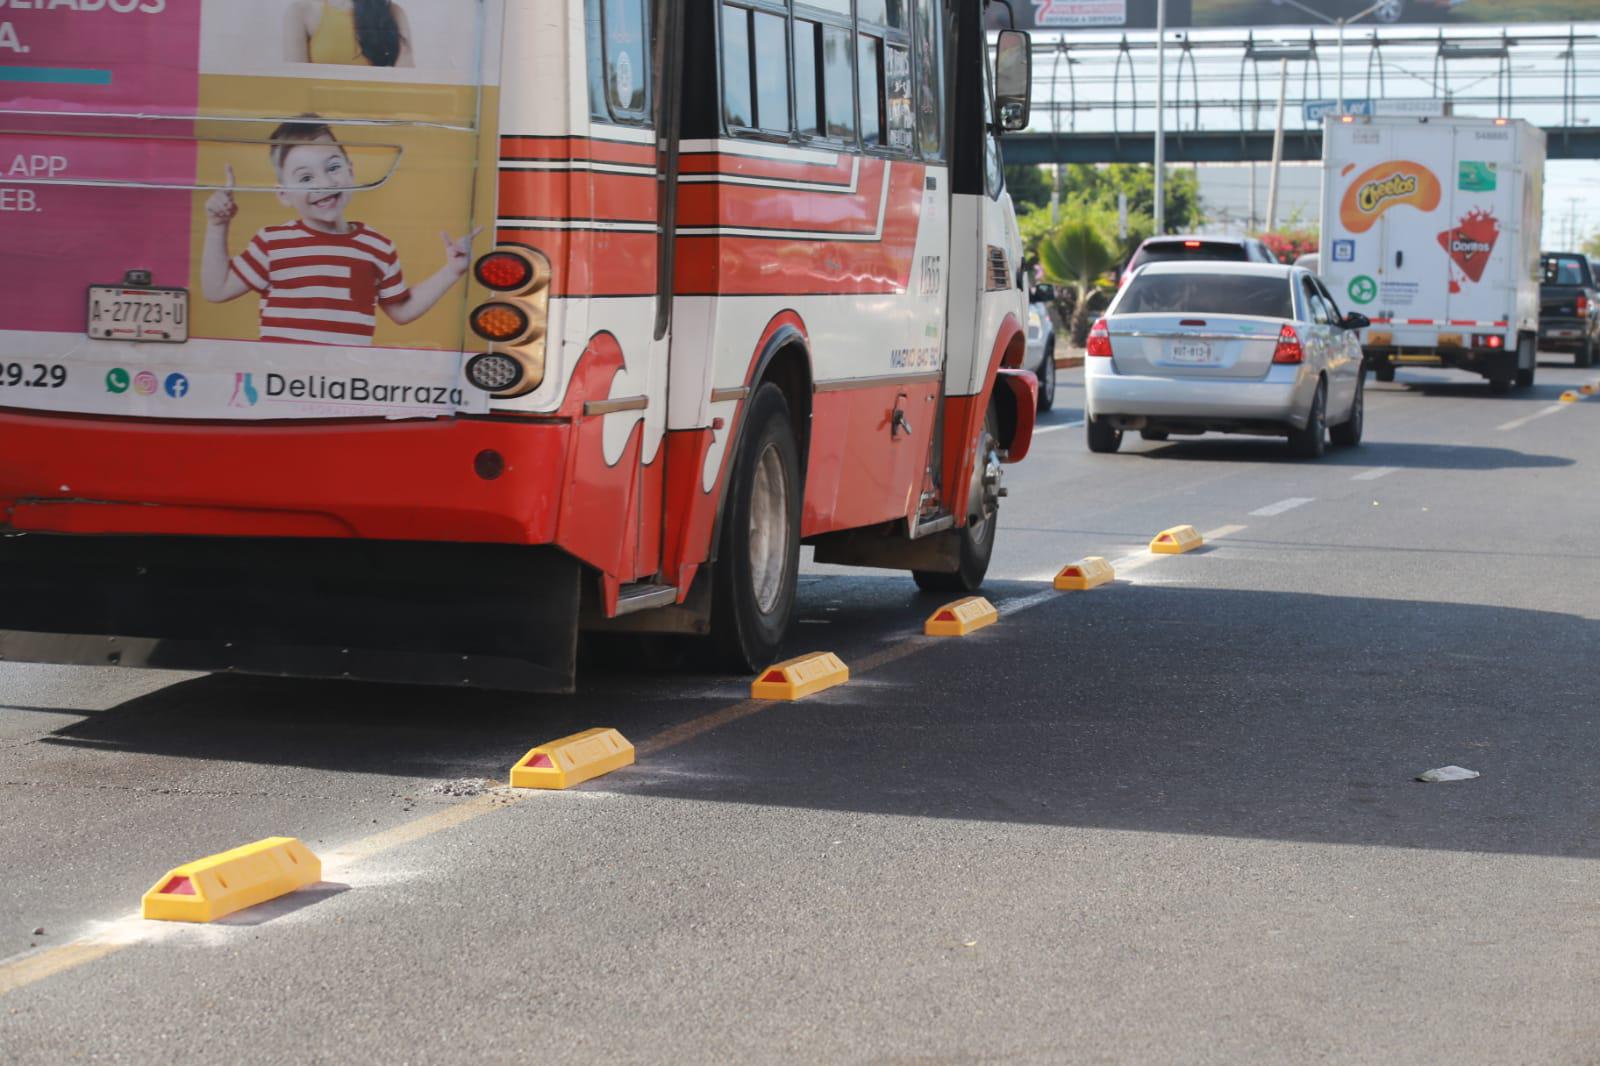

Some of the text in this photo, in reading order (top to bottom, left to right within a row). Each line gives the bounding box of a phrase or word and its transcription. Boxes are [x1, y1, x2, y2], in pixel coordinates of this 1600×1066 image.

[8, 154, 68, 177] APP
[1359, 174, 1417, 211] Cheetos
[1452, 240, 1490, 253] Doritos
[93, 300, 184, 325] A-27723-U
[0, 362, 67, 388] 9.29
